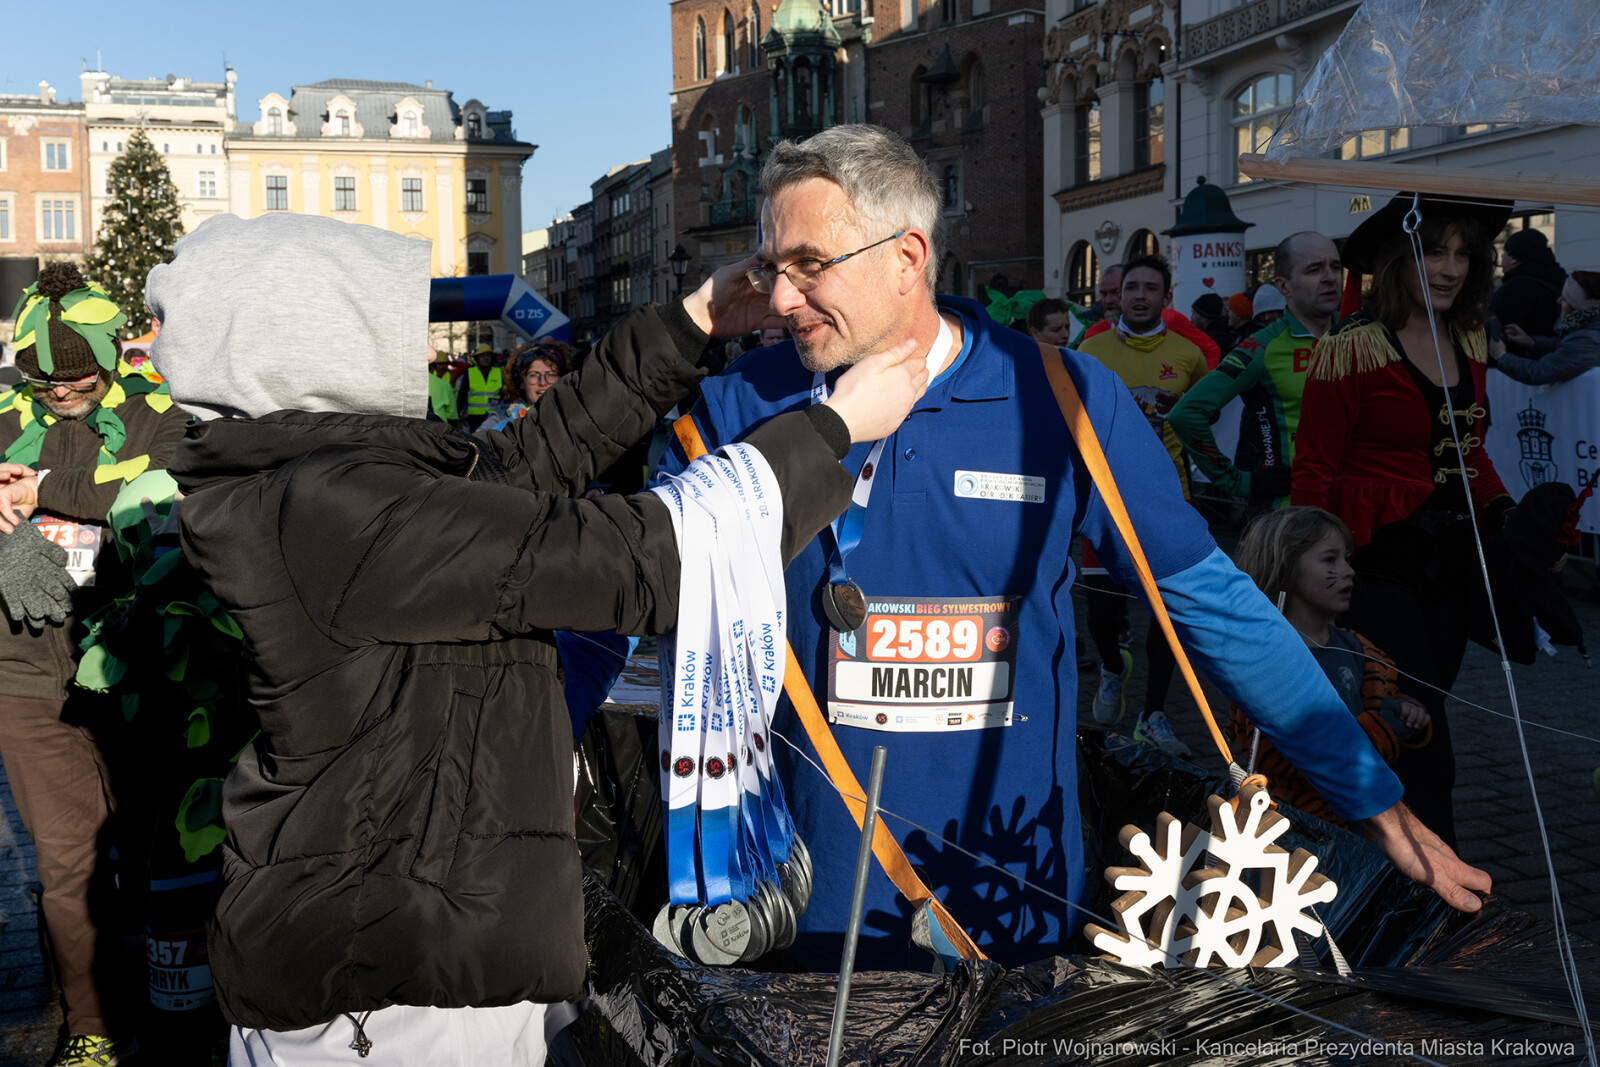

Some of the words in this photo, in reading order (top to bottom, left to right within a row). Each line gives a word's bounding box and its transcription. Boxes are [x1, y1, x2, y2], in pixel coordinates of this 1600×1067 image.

[528, 309, 544, 319] ZIS
[867, 602, 915, 614] AKOWSKI
[917, 603, 940, 614] BIEG
[942, 602, 1011, 614] SYLWESTROWY
[760, 623, 775, 671] Kraków
[872, 619, 978, 659] 2589
[681, 650, 696, 707] Kraków
[871, 667, 973, 698] MARCIN
[845, 713, 869, 721] Kraków
[147, 938, 187, 965] 357
